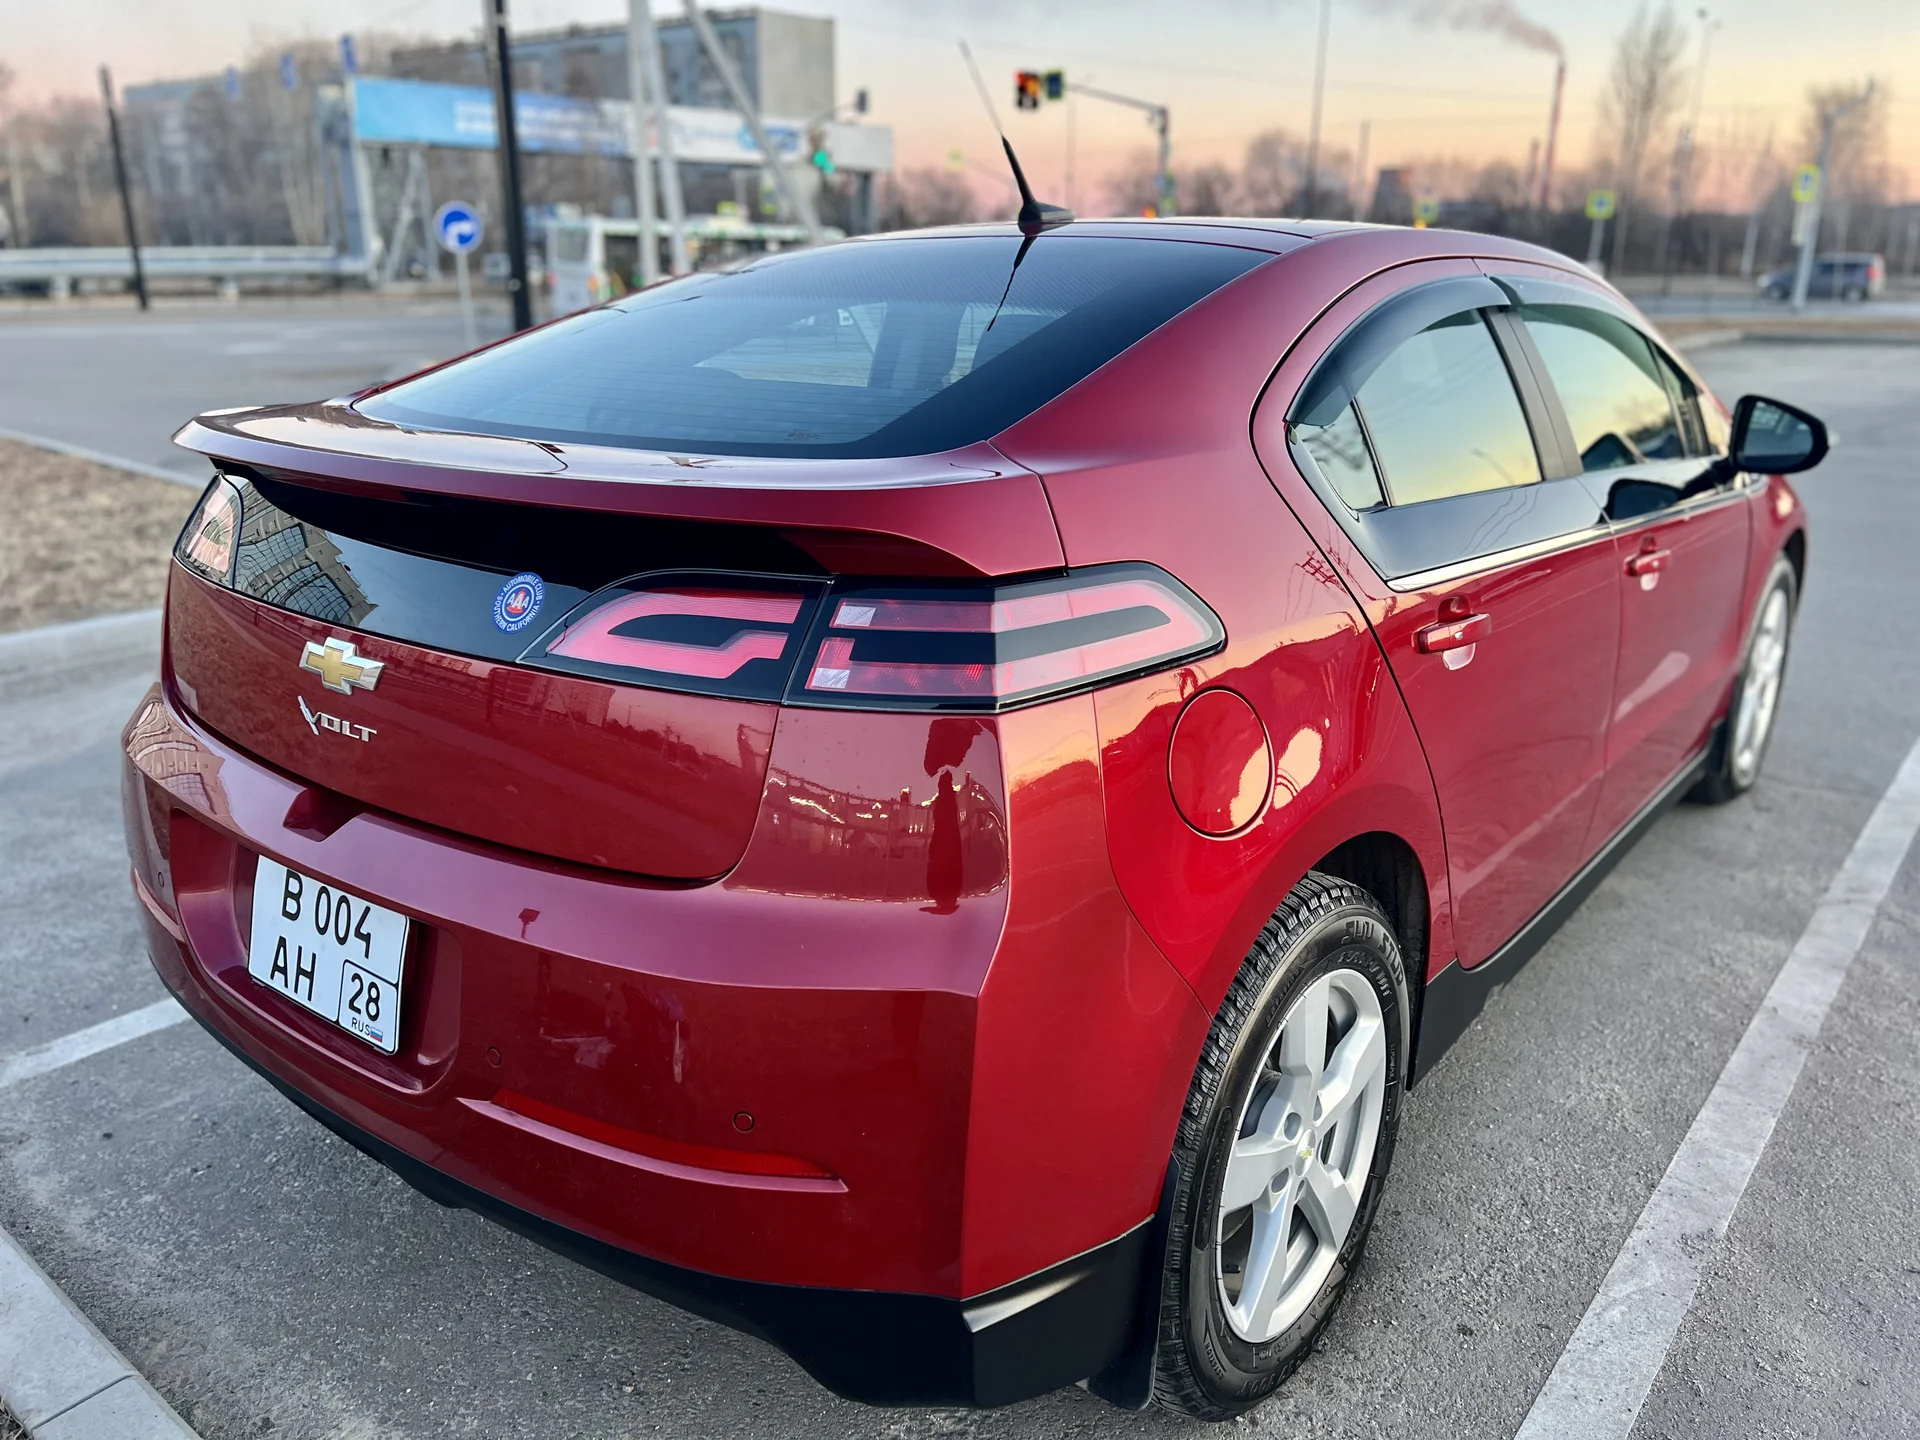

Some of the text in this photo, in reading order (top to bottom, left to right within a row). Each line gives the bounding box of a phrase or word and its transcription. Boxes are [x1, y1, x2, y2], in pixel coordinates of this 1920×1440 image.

[502, 574, 544, 601] AUTOMOBILE CLUB
[506, 592, 530, 609] AAA
[493, 595, 540, 632] SOUTHERN CALIFORNIA
[297, 695, 378, 743] VOLT
[314, 885, 372, 960] 004
[1376, 932, 1404, 987] STUD
[347, 972, 382, 1022] 28
[351, 1016, 371, 1037] RUS
